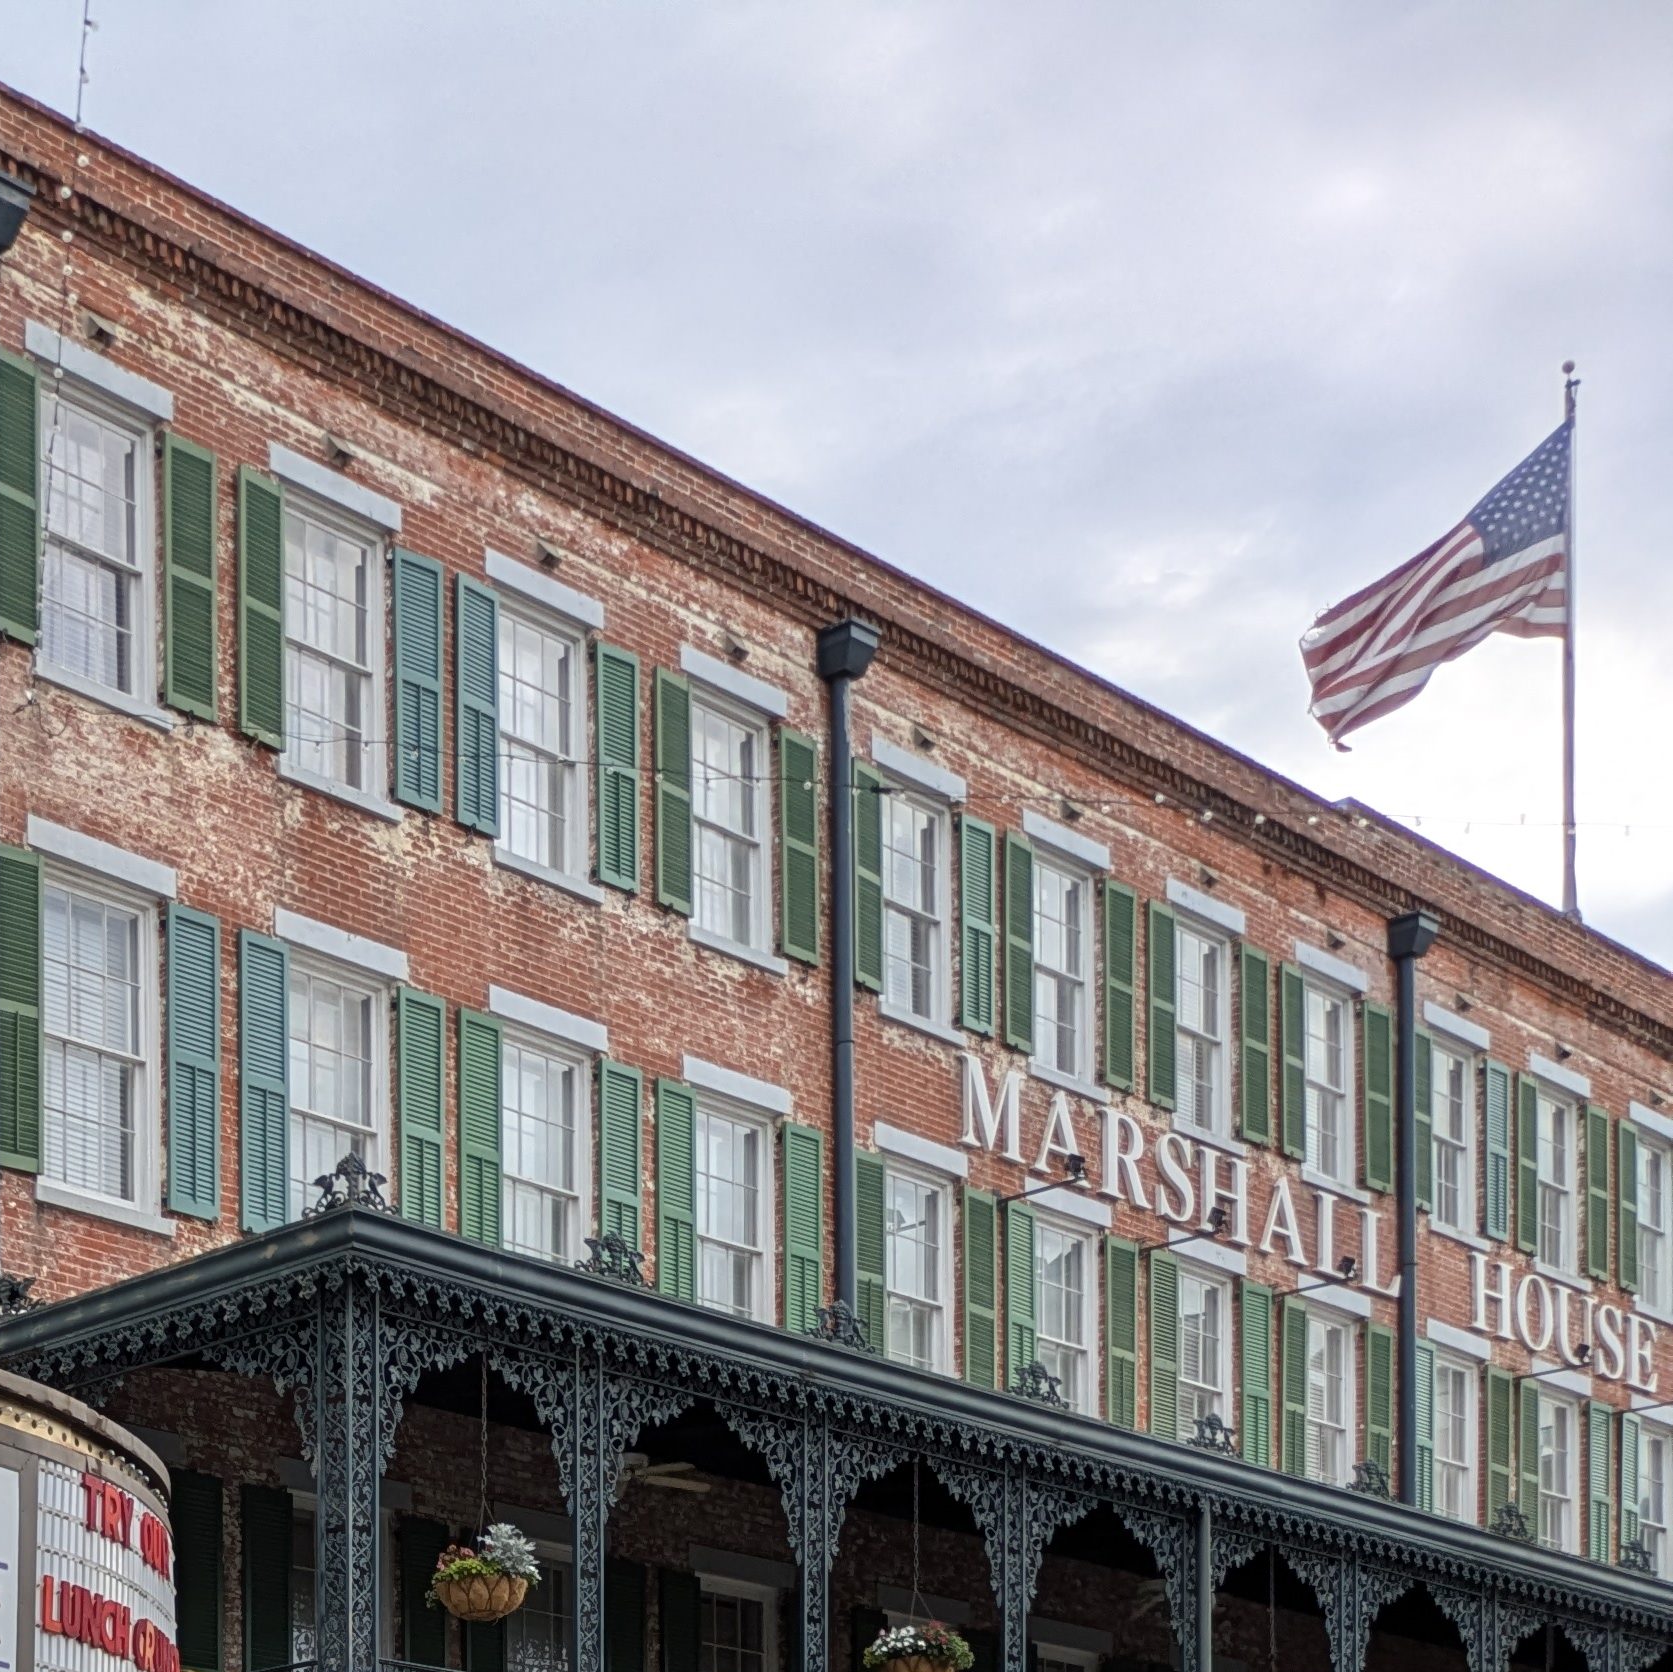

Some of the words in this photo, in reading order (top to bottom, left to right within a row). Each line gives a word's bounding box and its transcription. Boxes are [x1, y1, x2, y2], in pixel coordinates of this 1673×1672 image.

[958, 1052, 1403, 1298] MARSHALL
[1469, 1251, 1659, 1394] HOUSE
[82, 1472, 134, 1549] TRY
[42, 1574, 132, 1661] LUNCH
